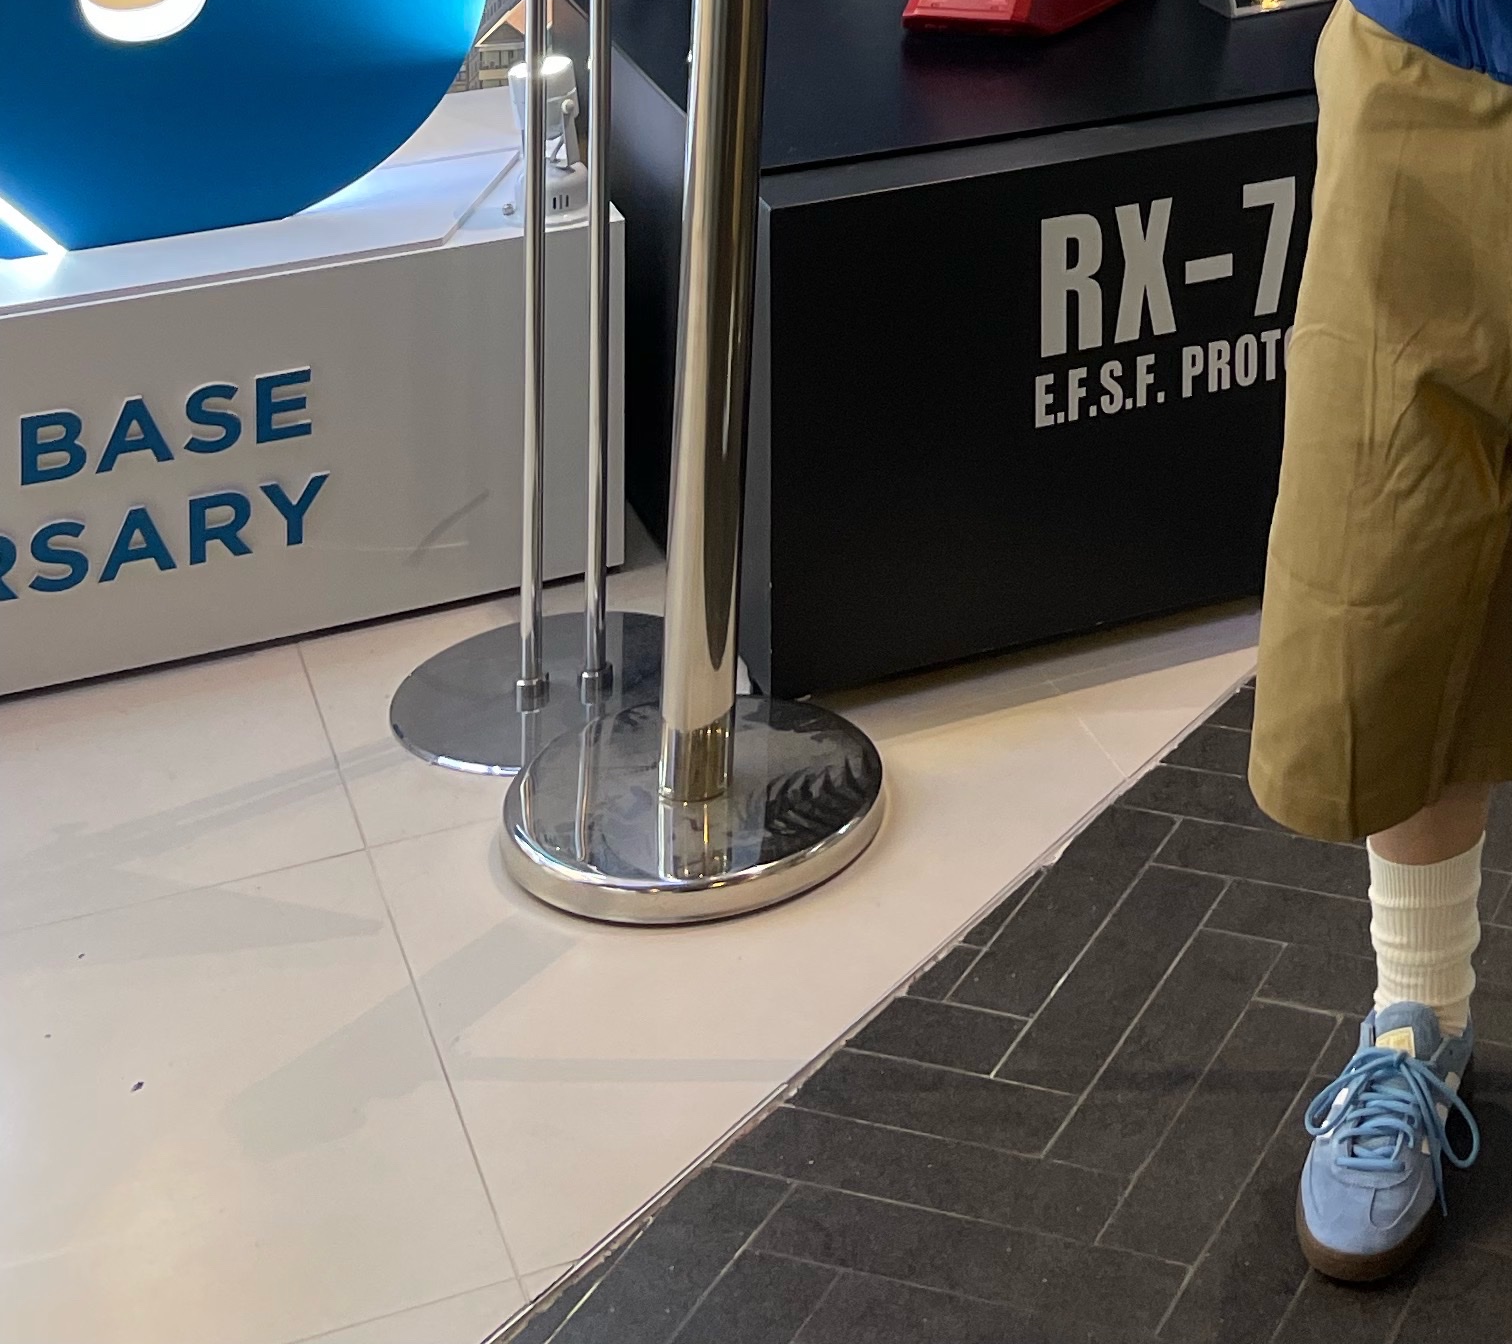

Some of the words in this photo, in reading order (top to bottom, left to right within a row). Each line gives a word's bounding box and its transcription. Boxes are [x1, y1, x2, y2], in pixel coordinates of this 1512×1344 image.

[1041, 176, 1314, 358] RX-7
[20, 365, 313, 486] BASE
[1035, 353, 1165, 428] E.F.S.F.
